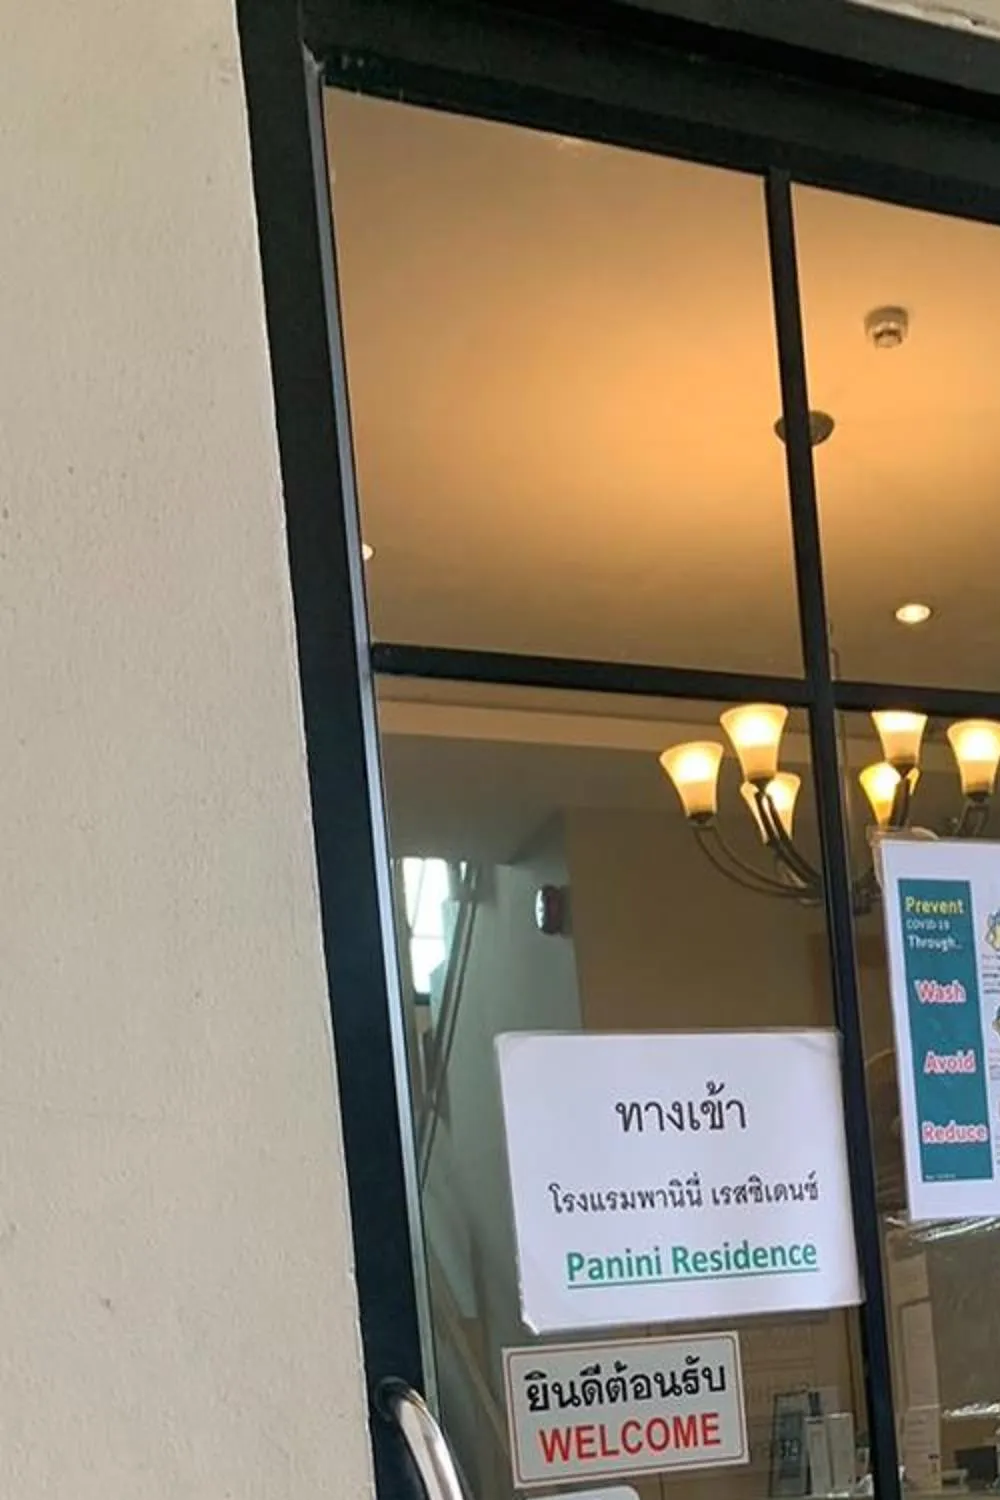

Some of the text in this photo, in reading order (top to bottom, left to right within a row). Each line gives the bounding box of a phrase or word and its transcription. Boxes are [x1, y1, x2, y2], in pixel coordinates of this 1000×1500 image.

[904, 895, 966, 915] Prevent
[914, 979, 968, 1005] Wash
[924, 1049, 977, 1075] Avoid
[615, 1081, 747, 1133] ทางเข้า
[921, 1119, 988, 1145] Reduce
[566, 1240, 817, 1281] Panini Residence
[524, 1355, 727, 1412] ยินดีต้อนรับ
[539, 1412, 722, 1464] WELCOME
